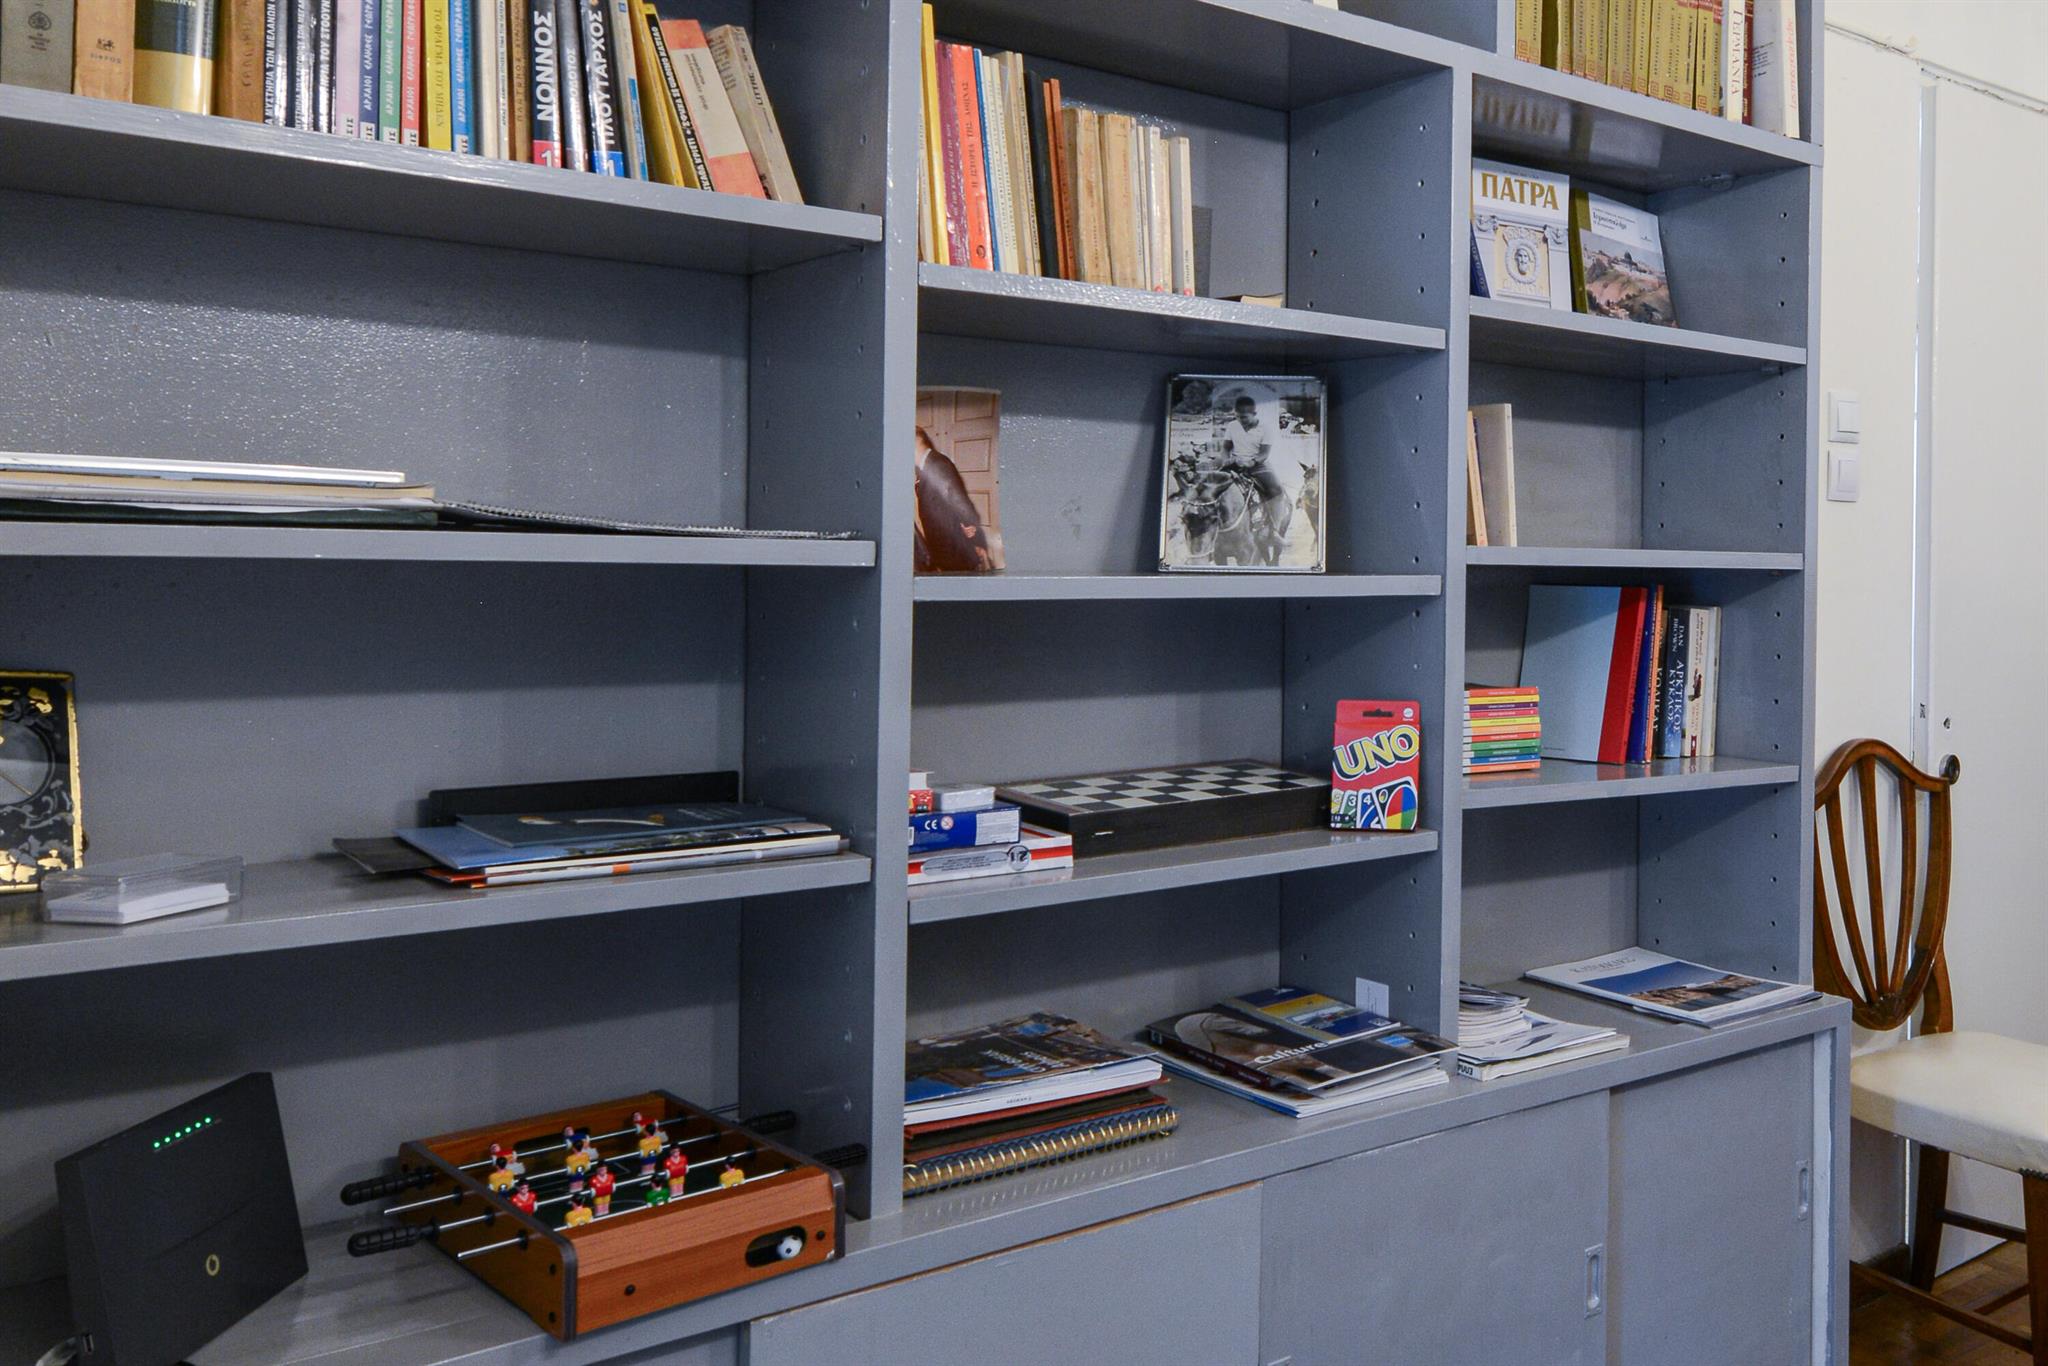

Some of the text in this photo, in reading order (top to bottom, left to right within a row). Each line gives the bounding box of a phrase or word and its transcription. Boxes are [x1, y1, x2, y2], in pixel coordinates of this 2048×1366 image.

[267, 4, 275, 48] ΜΕΛΑΝΩΝ
[266, 50, 275, 68] ΤΩΝ
[321, 42, 330, 61] ΤΟΥ
[434, 8, 443, 127] ΤΟ ΦΡΑΓΜΑ ΤΟΥ ΜΗΔΕΝ
[534, 10, 553, 121] ΝΟΝΝΟΣ
[1731, 10, 1743, 95] ΓΕΡΜΑΝΙΑ
[265, 71, 274, 116] ΜΥΣΤΗΡΙΑ
[363, 75, 372, 110] ΑΡΧΑΙΟΙ
[589, 10, 616, 145] ΠΛΟΥΤΑΡΧΟΣ
[386, 80, 394, 115] ΑΡΧΑΙΟΙ
[406, 86, 415, 121] ΑΡΧΑΙΟΙ
[457, 88, 465, 122] ΑΡΧΑΙΟΙ
[961, 82, 973, 116] ΑΘΗΝΑΣ
[965, 121, 975, 138] ΤΗΣ
[966, 143, 978, 177] ΙΣΤΟΡΙΑ
[1481, 172, 1559, 210] ΠΑΤΡΑ
[1667, 669, 1676, 721] ΚΥΚΛΟΣ
[1673, 660, 1684, 733] ΑΡΚΤΙΚΟΣ
[1333, 725, 1420, 781] UNO
[1348, 795, 1357, 806] 3
[1363, 794, 1372, 805] 4
[925, 819, 938, 830] CE
[1253, 1040, 1329, 1066] Culture
